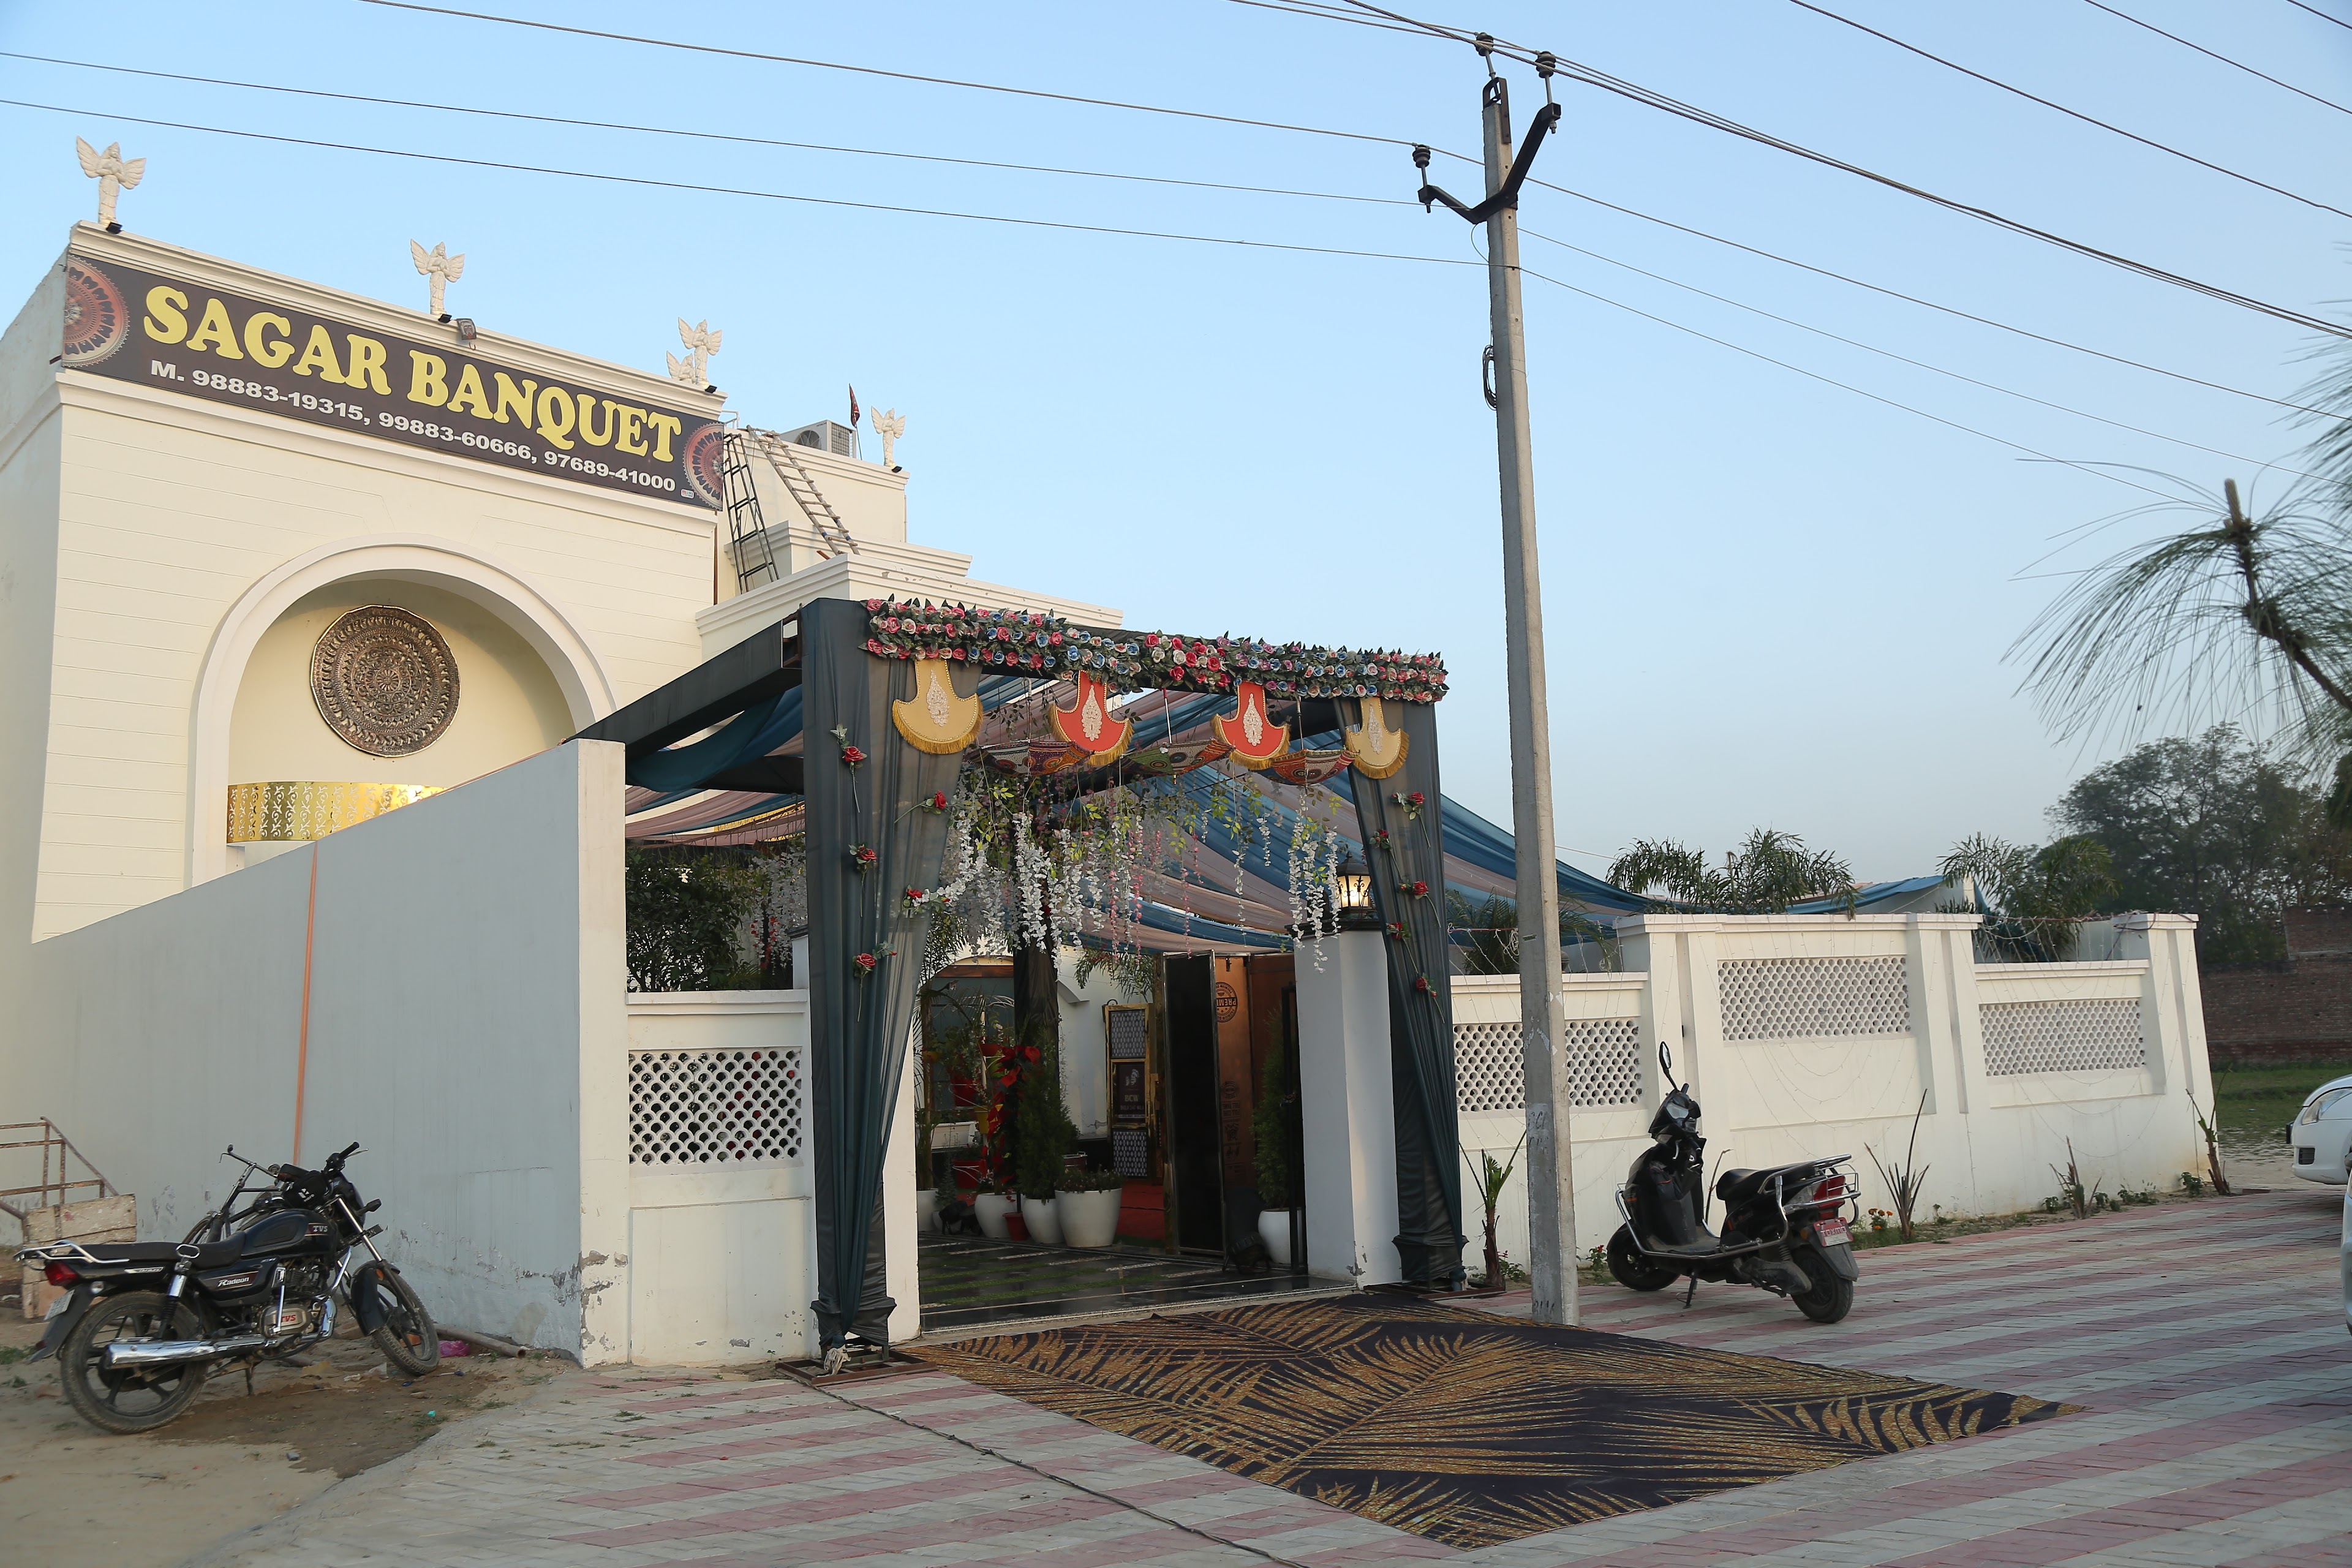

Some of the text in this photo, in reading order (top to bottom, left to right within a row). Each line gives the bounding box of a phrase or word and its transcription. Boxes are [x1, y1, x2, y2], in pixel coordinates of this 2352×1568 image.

[143, 285, 682, 462] SAGAR BANQUET
[151, 360, 676, 491] M. 98883-19315, 99883-60666, 97689-41000
[217, 1277, 250, 1287] Radeon
